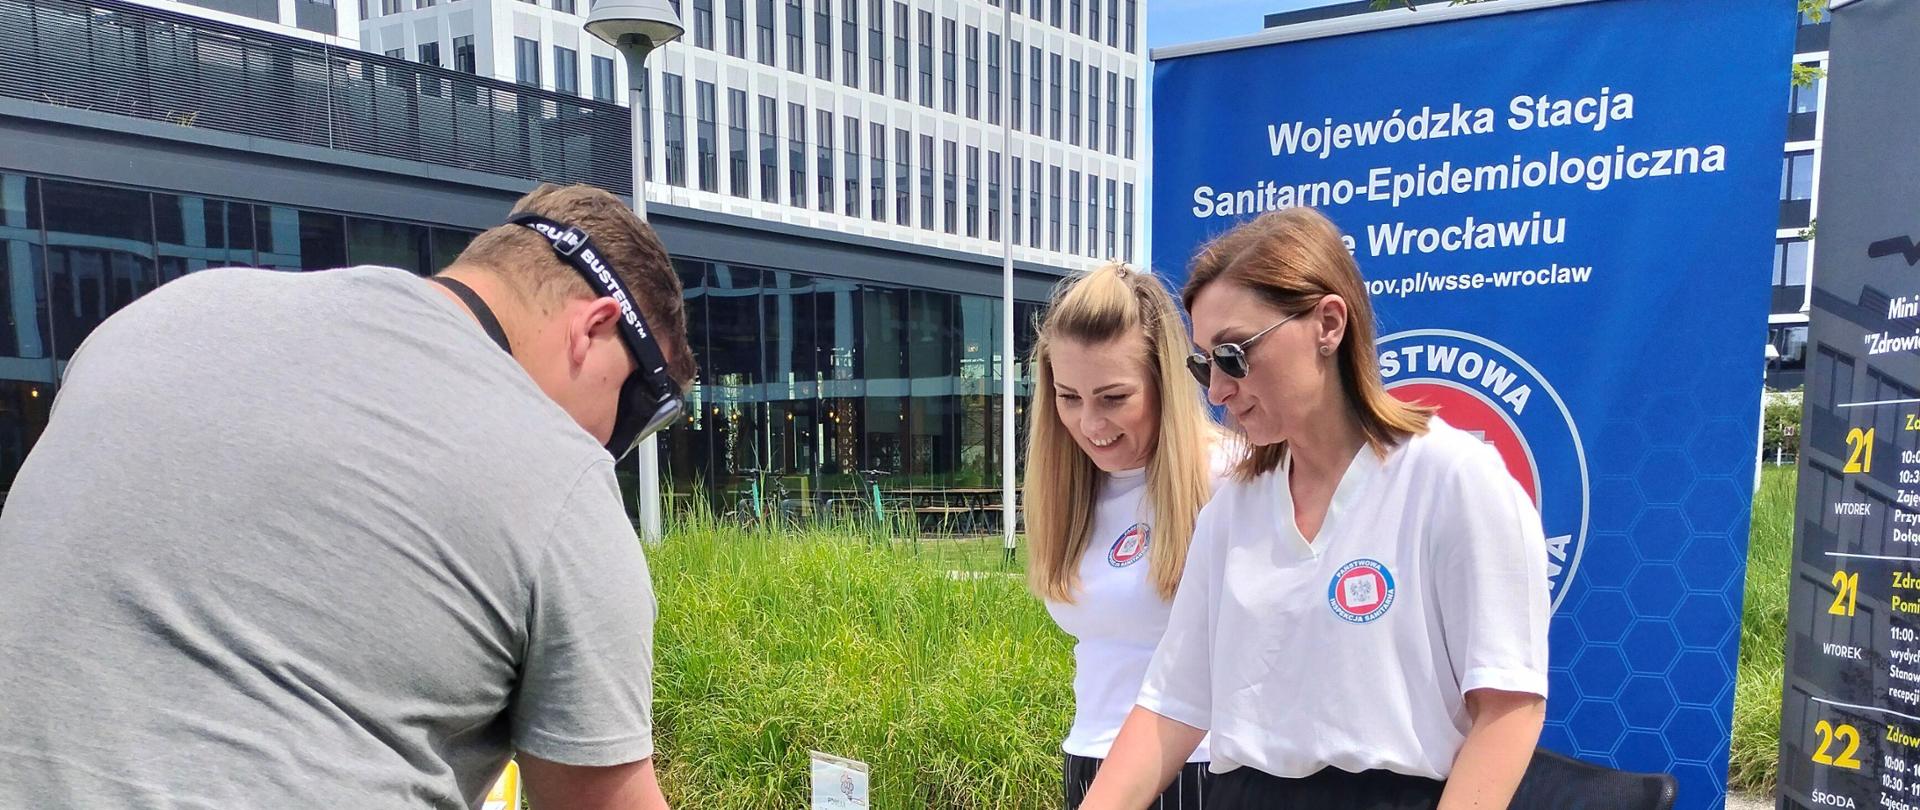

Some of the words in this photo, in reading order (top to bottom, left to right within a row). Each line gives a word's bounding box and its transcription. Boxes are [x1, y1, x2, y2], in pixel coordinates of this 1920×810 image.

[1267, 103, 1495, 159] Wojewódzka
[1508, 87, 1634, 132] Stacja
[1192, 144, 1726, 218] Sanitarno-Epidemiologiczna
[1367, 211, 1567, 257] Wrocławiu
[1888, 294, 1920, 320] Mini
[1864, 328, 1920, 355] "Zdrowi
[1379, 344, 1532, 416] STWOWA
[1842, 427, 1875, 473] 21
[1834, 502, 1871, 516] WTOREK
[1896, 489, 1920, 507] Zaję
[1893, 528, 1920, 546] Dołą
[1828, 570, 1859, 617] 21
[1890, 626, 1914, 642] 11:00
[1823, 643, 1862, 660] WTOREK
[1888, 687, 1920, 705] recepcji
[1811, 720, 1861, 770] 22
[1884, 754, 1905, 773] 10:00
[1882, 773, 1903, 792] 10:30
[1811, 788, 1855, 809] ŚRODA
